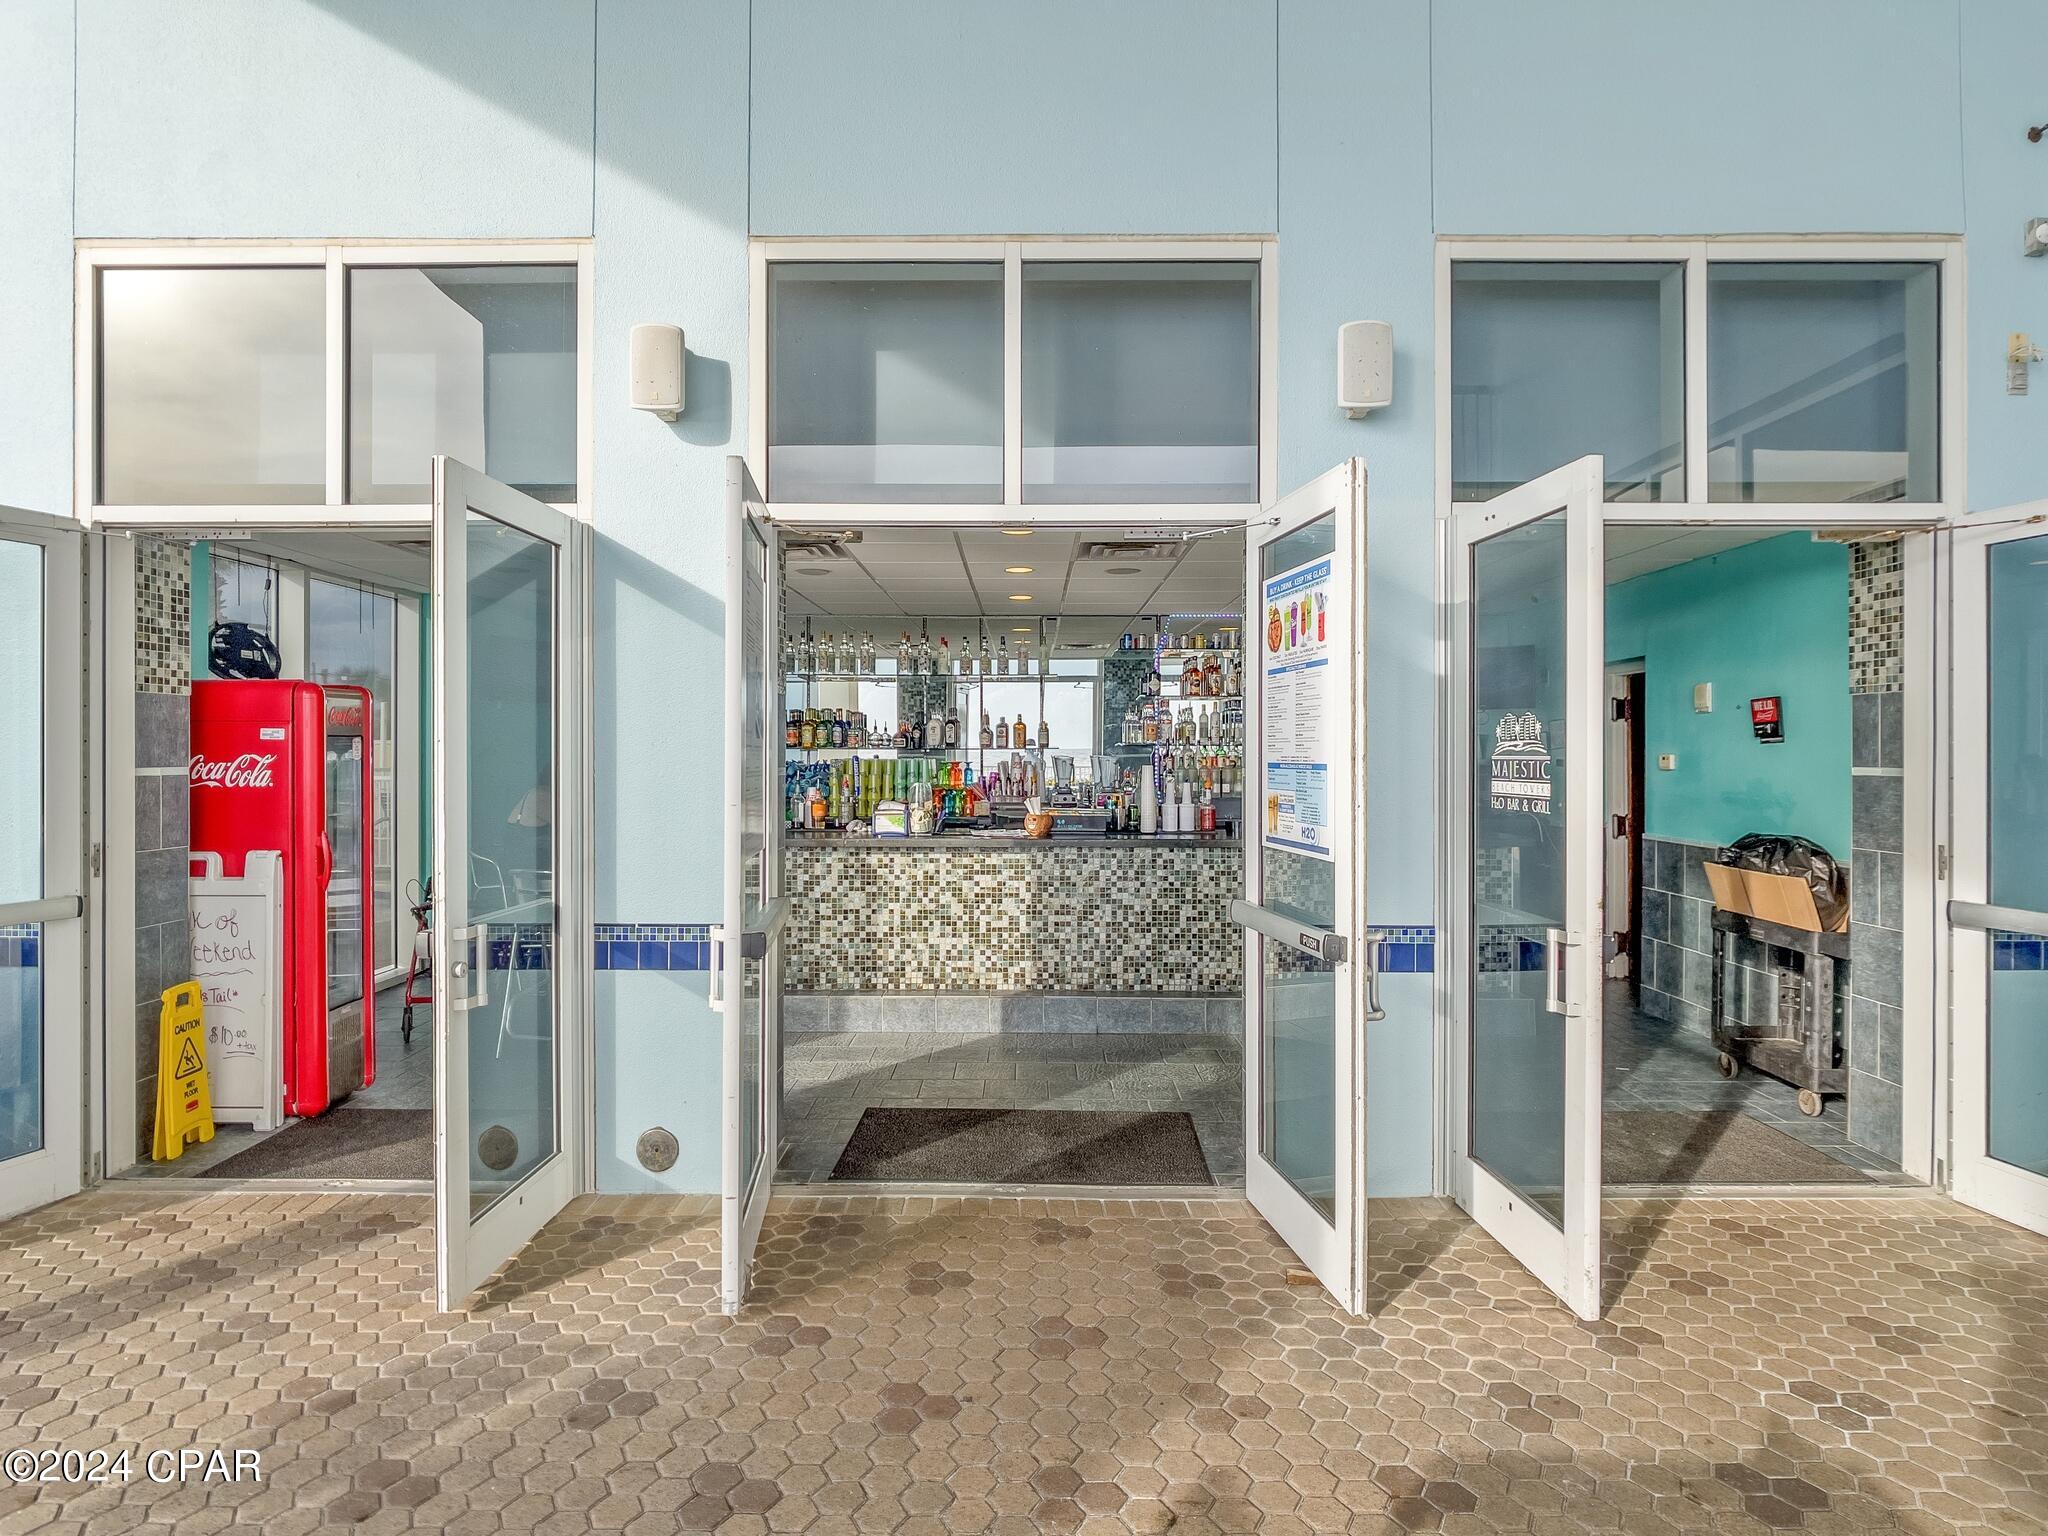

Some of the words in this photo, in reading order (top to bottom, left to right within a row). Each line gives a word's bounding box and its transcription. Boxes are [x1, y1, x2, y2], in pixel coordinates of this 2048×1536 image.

[1304, 572, 1313, 583] THE
[1313, 567, 1328, 578] GLASS
[190, 754, 277, 788] Coca-Cola
[1491, 760, 1551, 781] MAJESTIC
[1492, 783, 1516, 793] BEACH
[1519, 784, 1550, 796] TOWERS
[1507, 798, 1520, 811] BAR
[1522, 799, 1529, 812] &
[1531, 800, 1551, 815] GRILL
[1301, 826, 1316, 841] H2O
[215, 908, 239, 938] of
[1302, 934, 1318, 950] PUSH
[175, 1018, 201, 1035] CAUTION
[186, 1080, 196, 1089] WET
[184, 1087, 199, 1099] FLOOR
